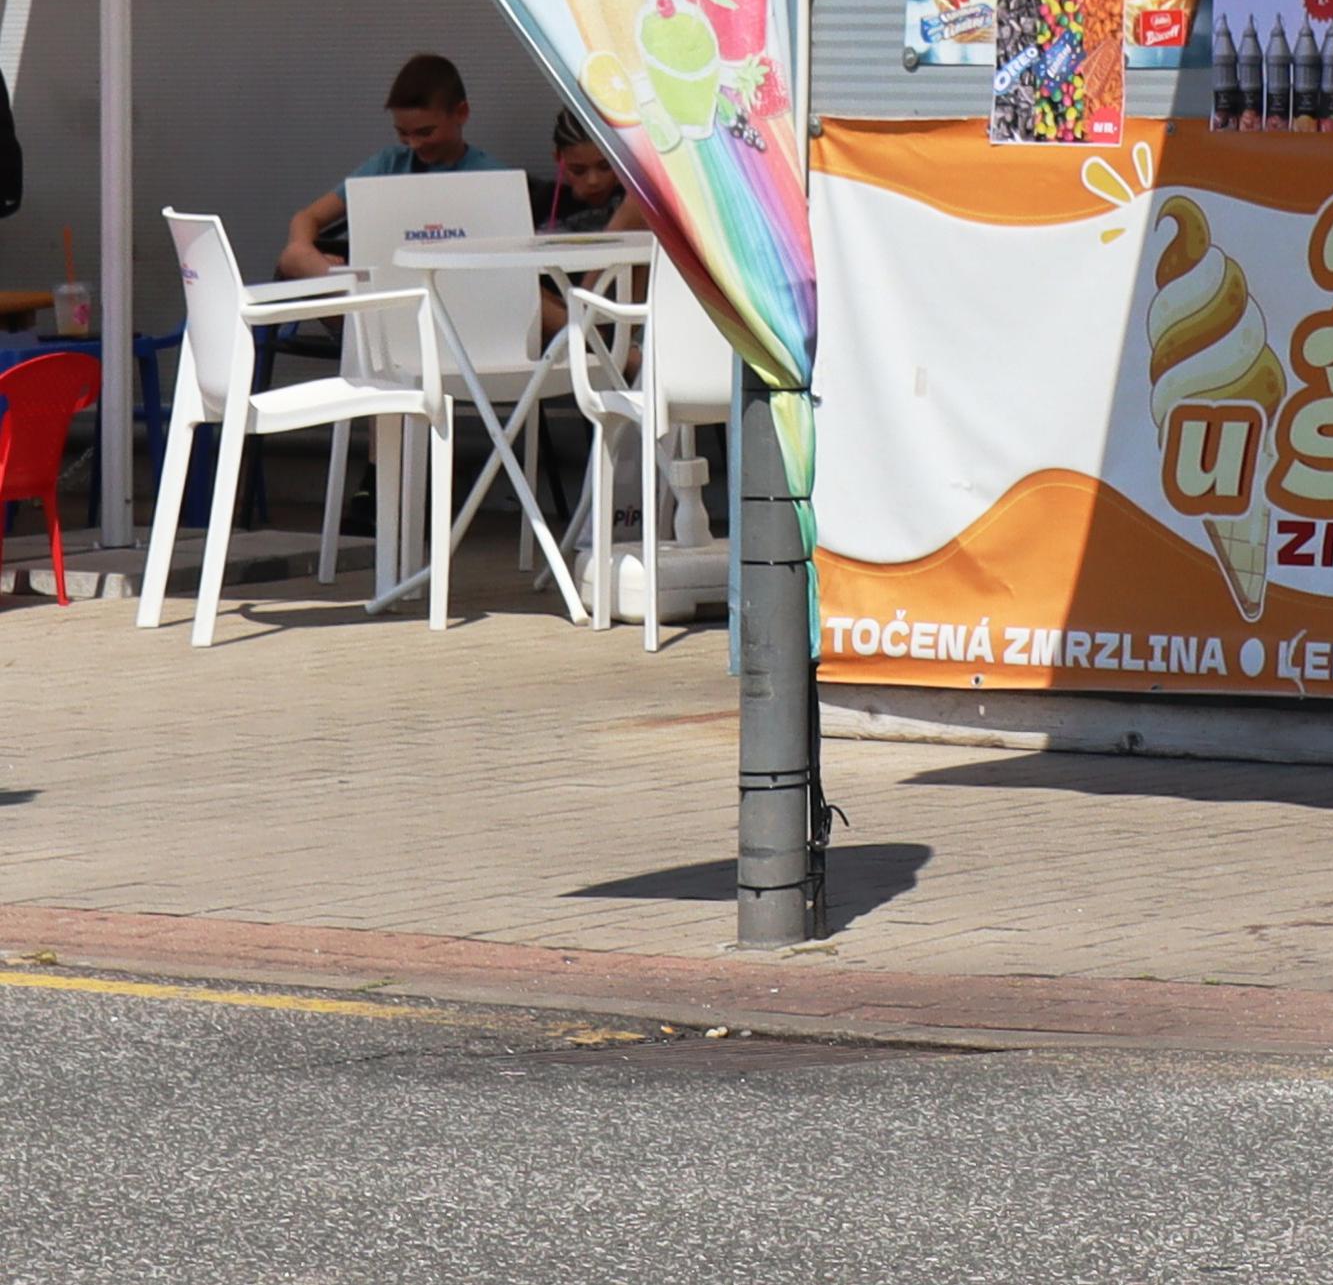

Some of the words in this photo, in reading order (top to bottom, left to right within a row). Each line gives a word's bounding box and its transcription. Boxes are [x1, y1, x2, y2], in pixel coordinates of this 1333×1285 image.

[1174, 416, 1249, 498] u
[826, 610, 994, 664] TOČENÁ
[1003, 628, 1228, 676] ZMRZLINA
